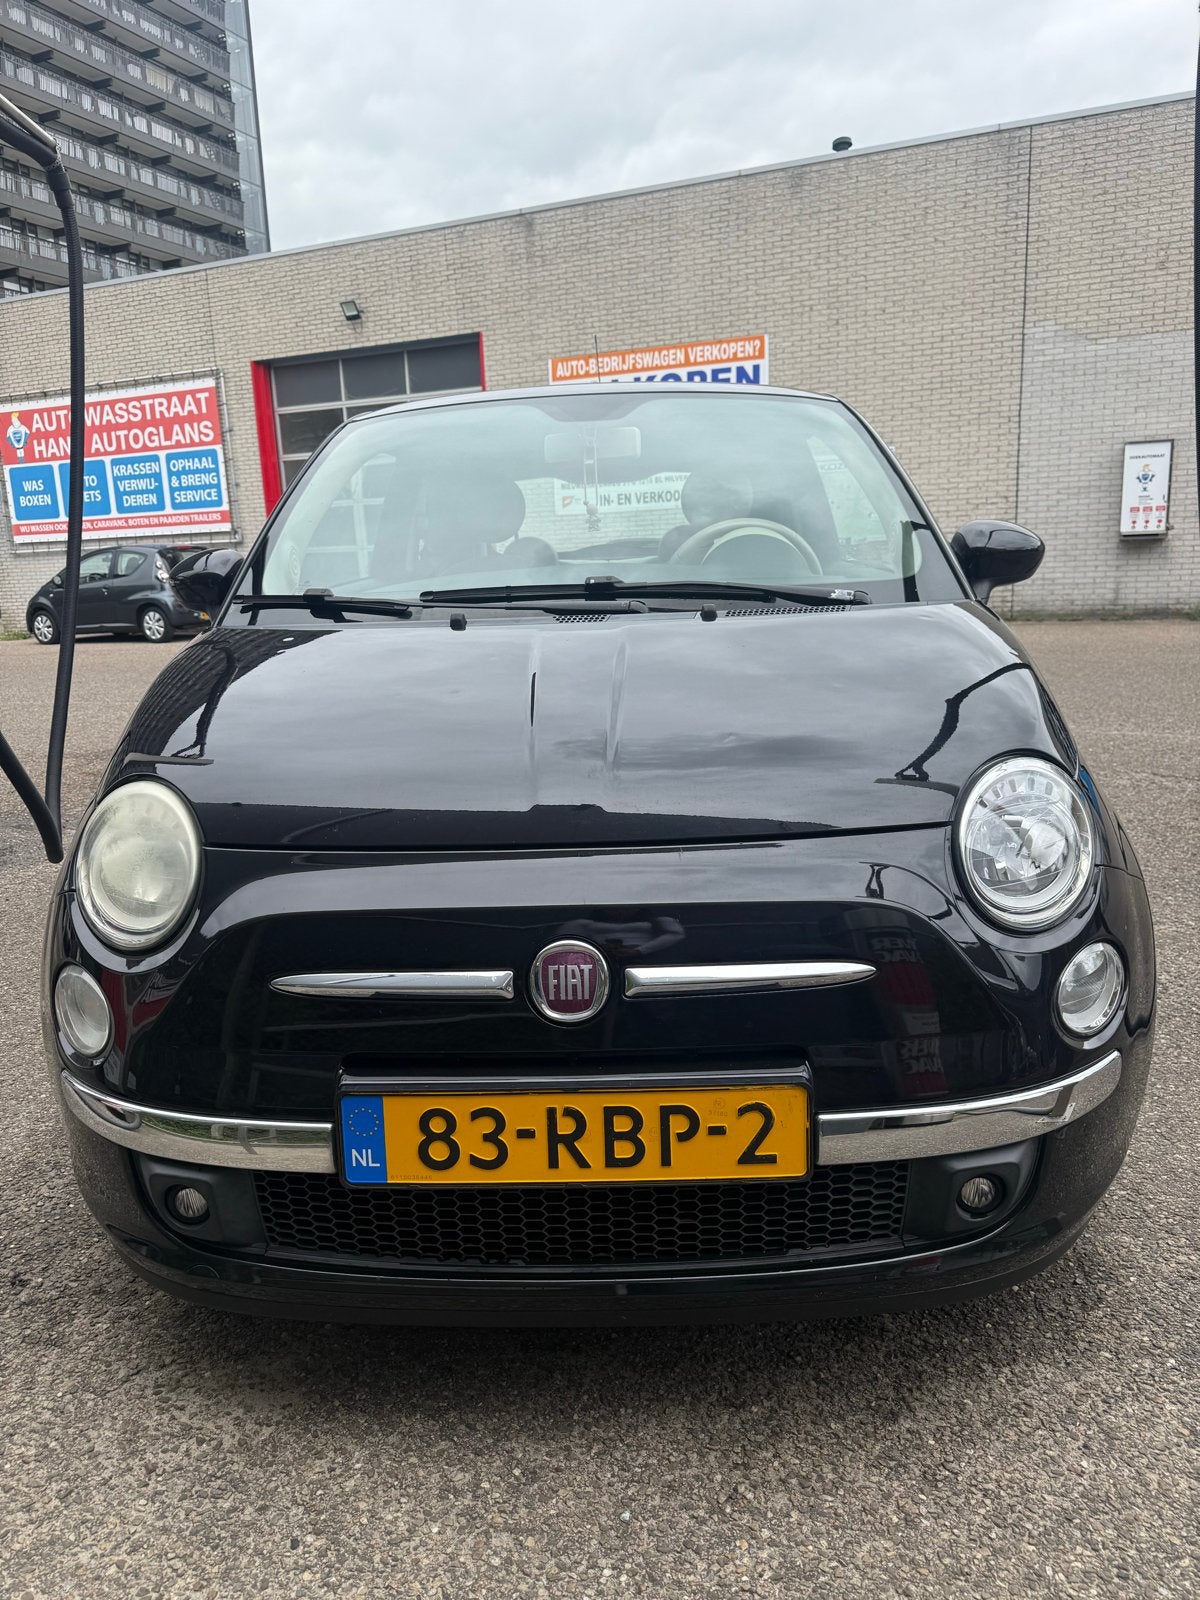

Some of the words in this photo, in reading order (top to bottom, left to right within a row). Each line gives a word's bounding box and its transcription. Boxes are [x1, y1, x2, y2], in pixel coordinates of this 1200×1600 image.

[556, 348, 685, 378] AUTO-BEDRIJFSWAGEN
[689, 339, 761, 363] VERKOPEN?
[31, 392, 210, 433] AUTWASSTRAAT
[33, 436, 70, 459] HAN
[91, 421, 214, 453] AUTOGLANS
[113, 461, 160, 477] KRASSEN
[170, 457, 215, 472] OPHAAL
[22, 479, 44, 492] WAS
[83, 475, 98, 487] TO
[117, 479, 159, 492] VERWIJ-
[171, 478, 180, 488] &
[181, 473, 218, 486] BRENG
[20, 494, 51, 507] BOXEN
[83, 490, 102, 502] ETS
[123, 494, 157, 507] DEREN
[174, 489, 218, 503] SERVICE
[600, 493, 614, 506] IN-
[617, 492, 632, 506] EN
[634, 490, 681, 504] VERKOO
[31, 524, 54, 532] WASSEN
[128, 517, 149, 526] BOTEN
[150, 517, 159, 525] EN
[160, 515, 190, 524] PAARDEN
[190, 513, 221, 523] TRAILERS
[547, 963, 593, 1000] FIAT
[417, 1101, 778, 1171] 83-RBP-2
[351, 1148, 381, 1168] NL
